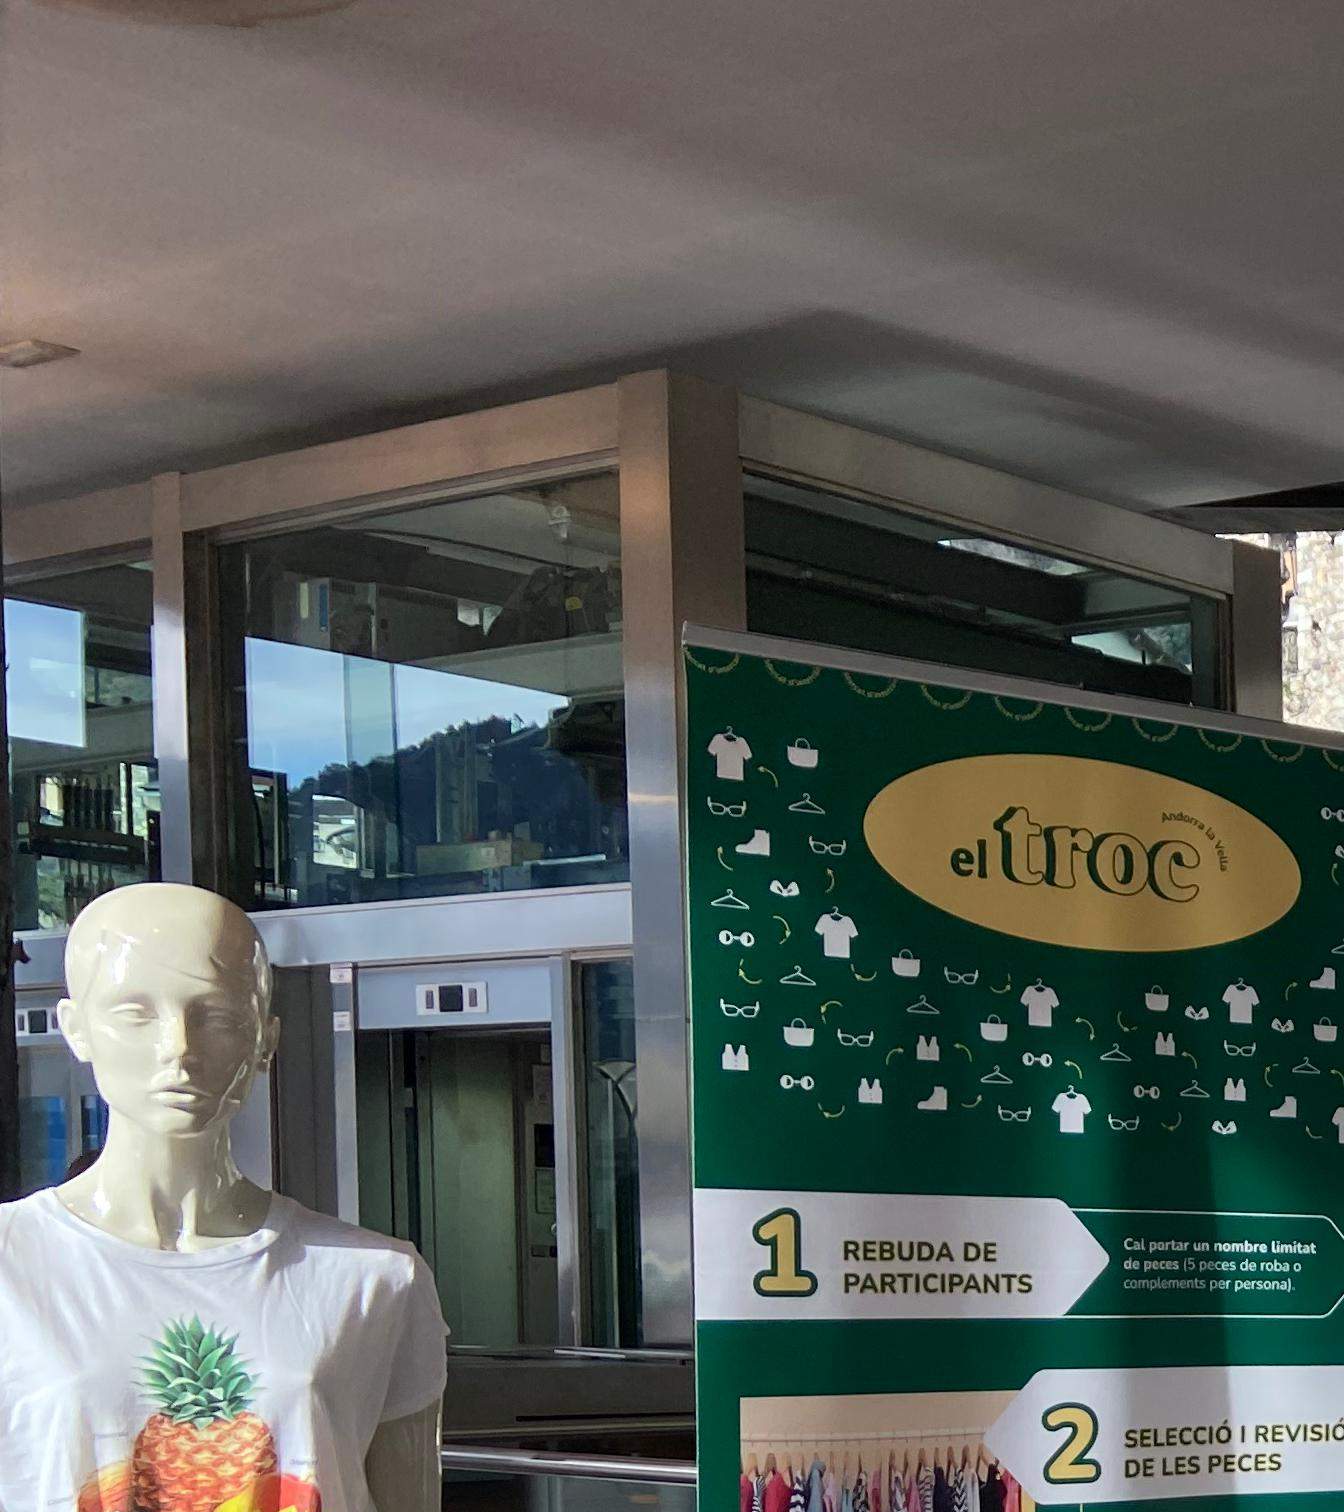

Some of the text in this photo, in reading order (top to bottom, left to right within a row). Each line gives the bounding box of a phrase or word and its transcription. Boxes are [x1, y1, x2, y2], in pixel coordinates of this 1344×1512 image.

[950, 806, 1200, 902] el troc
[1162, 811, 1228, 872] Andorra la Vella
[752, 1206, 818, 1297] 1
[843, 1240, 996, 1262] REBUDA DE
[1124, 1238, 1316, 1254] Cal portar un nombre limitat
[1124, 1258, 1301, 1274] de peces (5 peces de roba o
[844, 1272, 1033, 1294] PARTICIPANTS
[1124, 1277, 1296, 1292] complements per persona).
[1041, 1402, 1102, 1484] 2
[1125, 1420, 1232, 1448] SELECCIÓ
[1241, 1425, 1246, 1444] I
[1125, 1452, 1281, 1478] DE LES PECES
